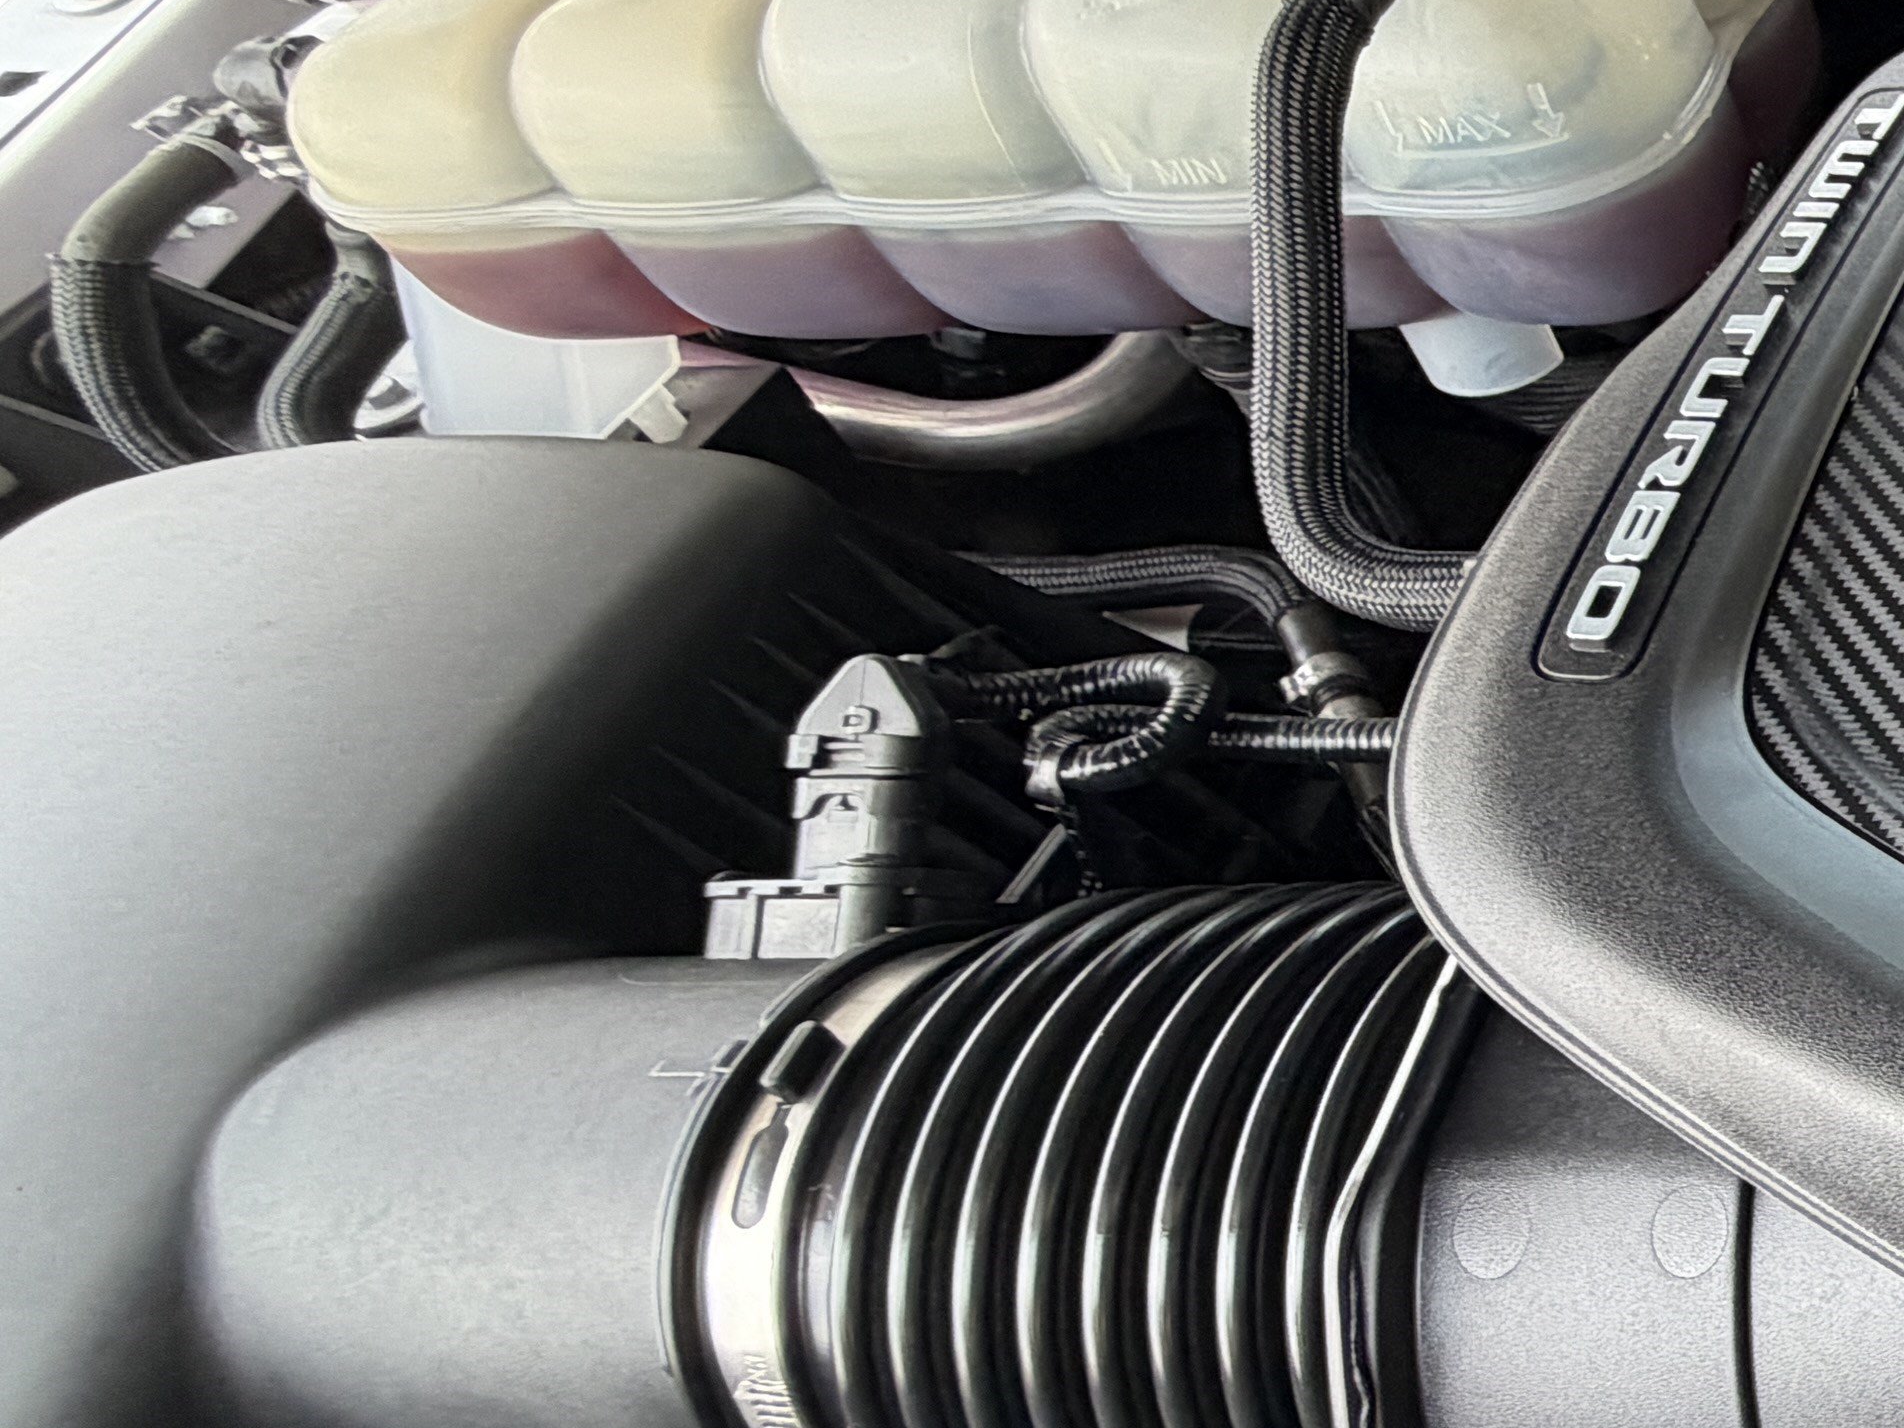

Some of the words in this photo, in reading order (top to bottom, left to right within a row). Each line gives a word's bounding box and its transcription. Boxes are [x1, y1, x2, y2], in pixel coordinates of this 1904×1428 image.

[1416, 110, 1512, 144] MAX
[1150, 156, 1228, 186] MIN
[1566, 294, 1784, 651] TURBO
